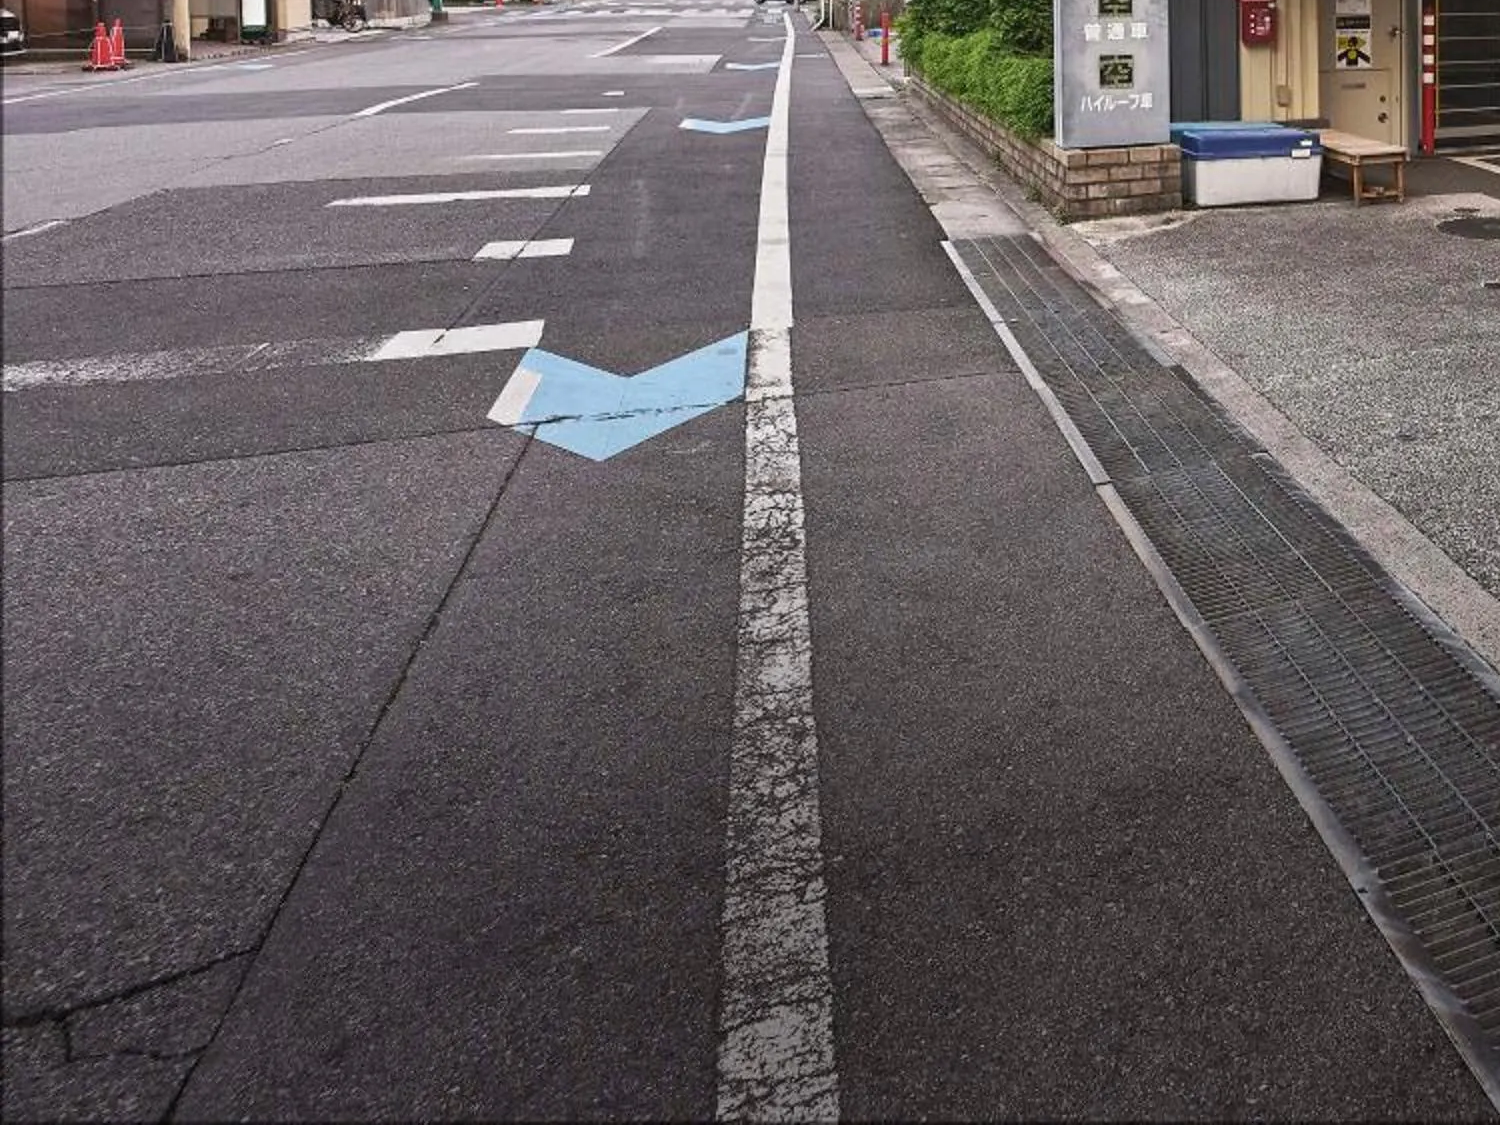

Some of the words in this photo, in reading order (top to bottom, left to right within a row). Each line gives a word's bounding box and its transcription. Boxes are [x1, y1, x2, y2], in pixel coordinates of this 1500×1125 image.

[1081, 93, 1153, 112] ハイルーフ車
